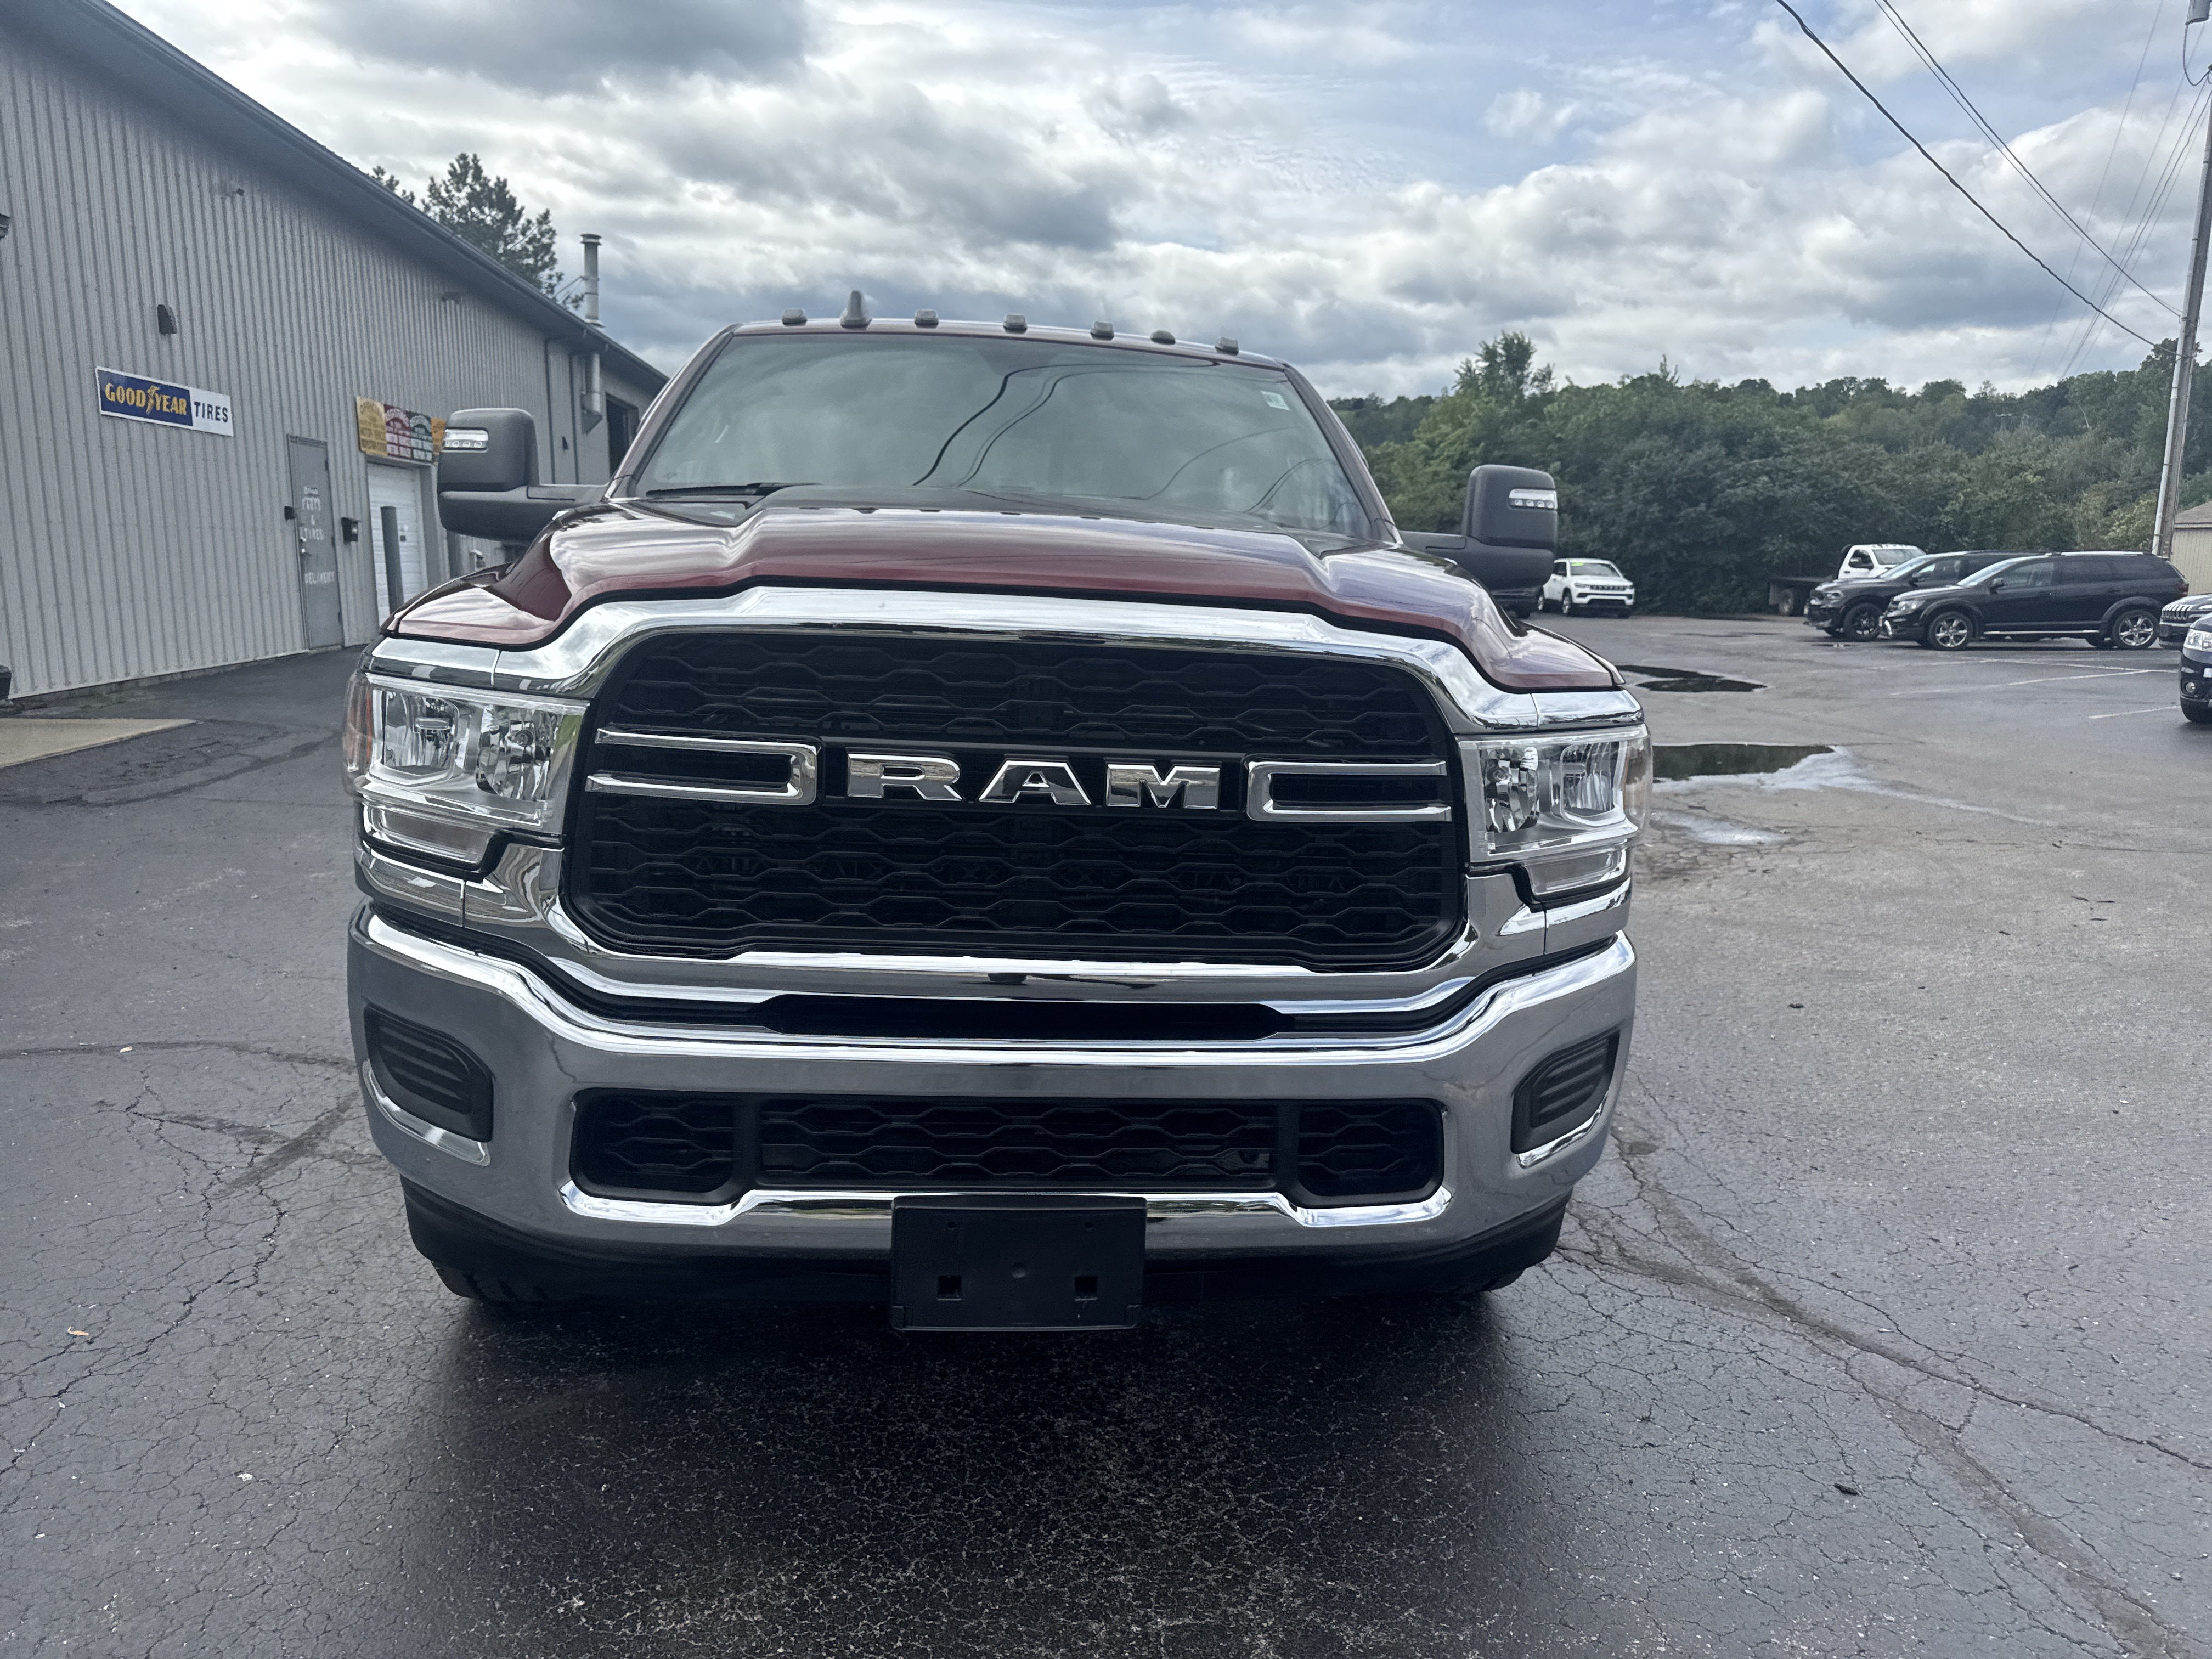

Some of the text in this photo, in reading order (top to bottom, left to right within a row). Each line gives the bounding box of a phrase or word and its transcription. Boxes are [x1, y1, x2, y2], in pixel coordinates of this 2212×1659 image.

[105, 383, 228, 422] GOODYEAR TIRES
[847, 753, 1221, 809] RAM
